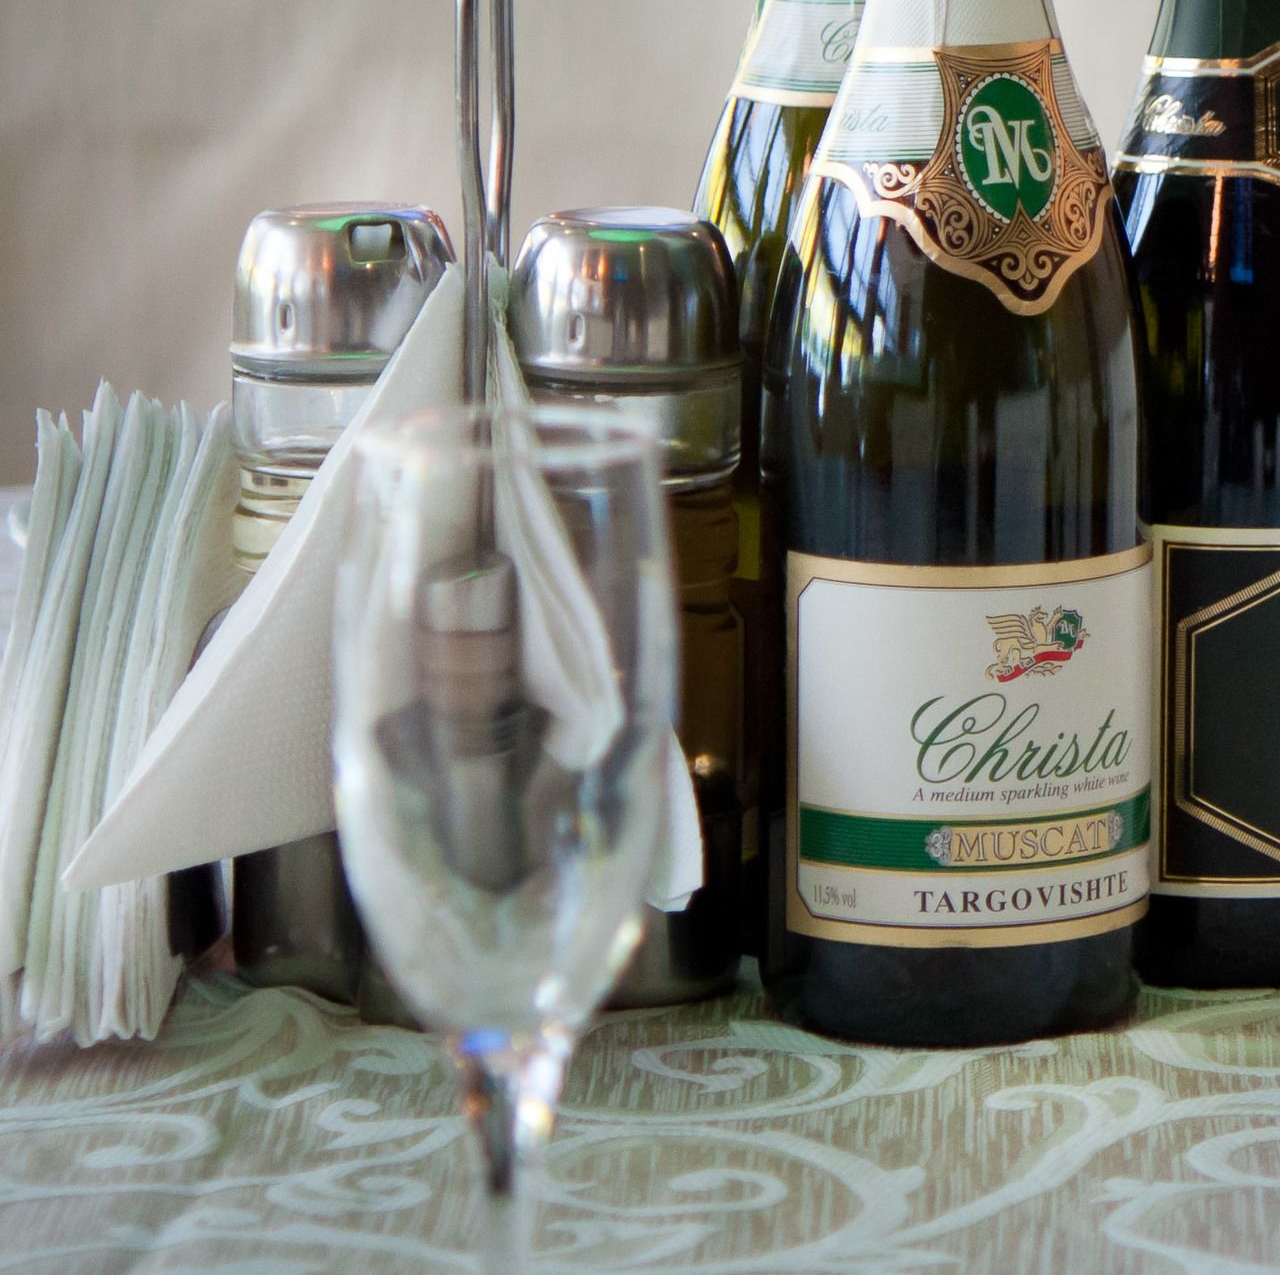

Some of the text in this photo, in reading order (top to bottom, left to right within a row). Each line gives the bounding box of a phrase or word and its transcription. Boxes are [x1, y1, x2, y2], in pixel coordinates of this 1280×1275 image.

[910, 692, 1133, 784] Christa
[912, 771, 1130, 805] A medium sparkling white wine
[953, 819, 1107, 862] MUSCAT
[914, 870, 1129, 913] TARGOVISHTE
